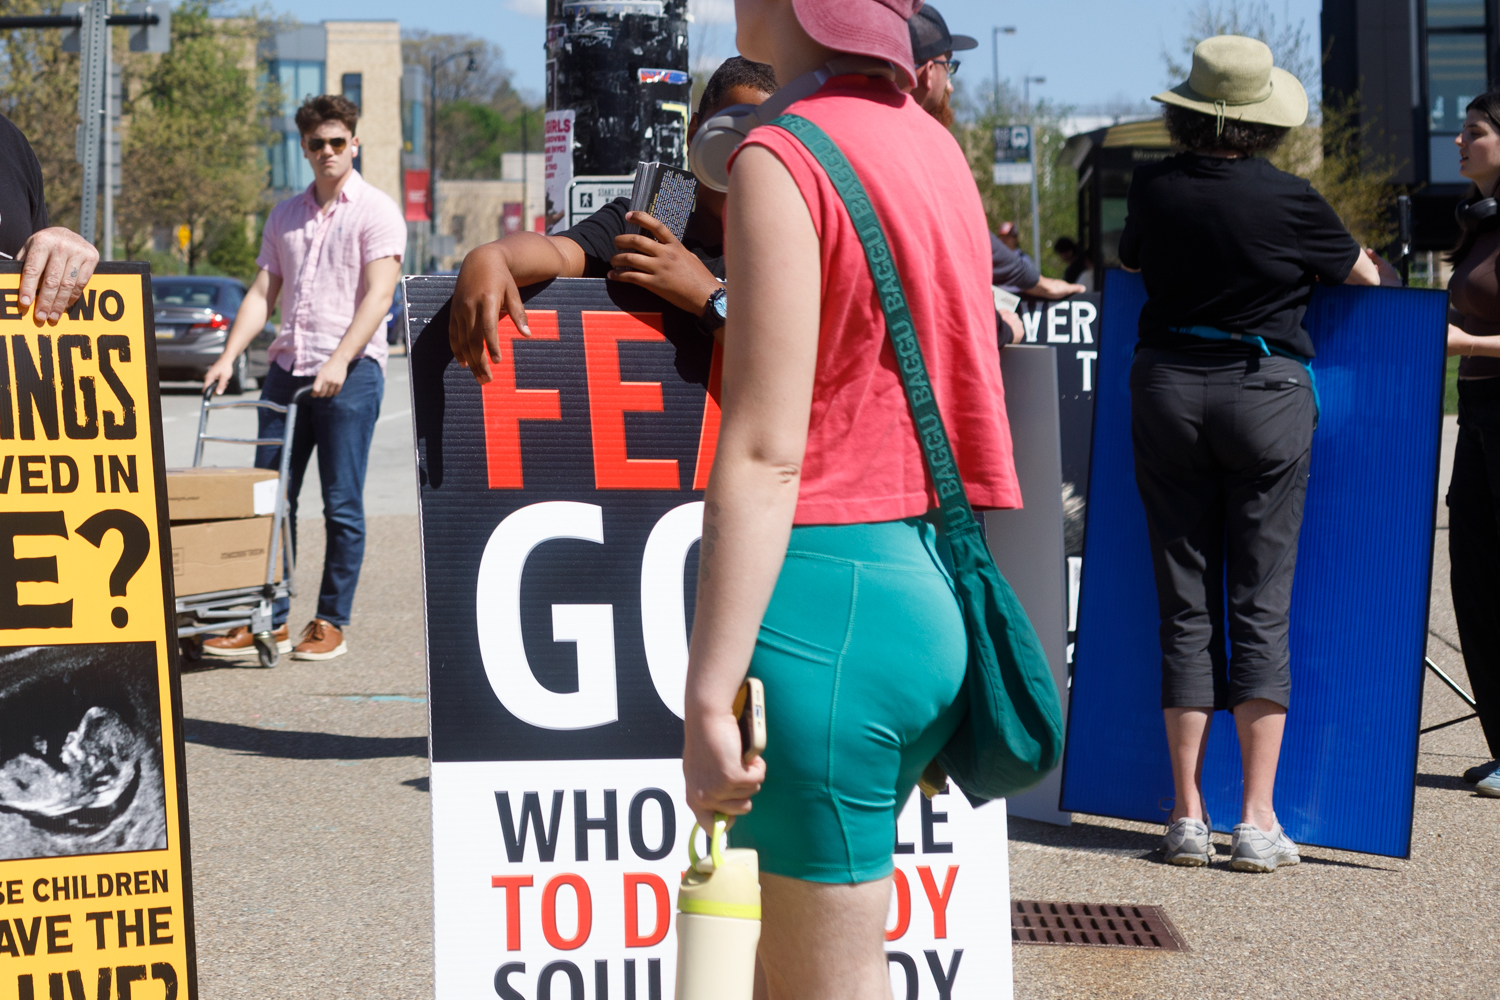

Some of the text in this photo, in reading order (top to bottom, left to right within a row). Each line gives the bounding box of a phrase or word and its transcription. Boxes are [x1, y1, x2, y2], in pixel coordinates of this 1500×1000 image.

[63, 288, 125, 322] WO
[861, 224, 905, 315] BAGGU
[891, 319, 934, 407] BAGGU
[93, 454, 139, 494] IN
[918, 412, 962, 499] BAGGU
[494, 786, 677, 863] WHO
[32, 868, 170, 903] CHILDREN
[491, 872, 593, 952] TO
[85, 906, 175, 951] THE
